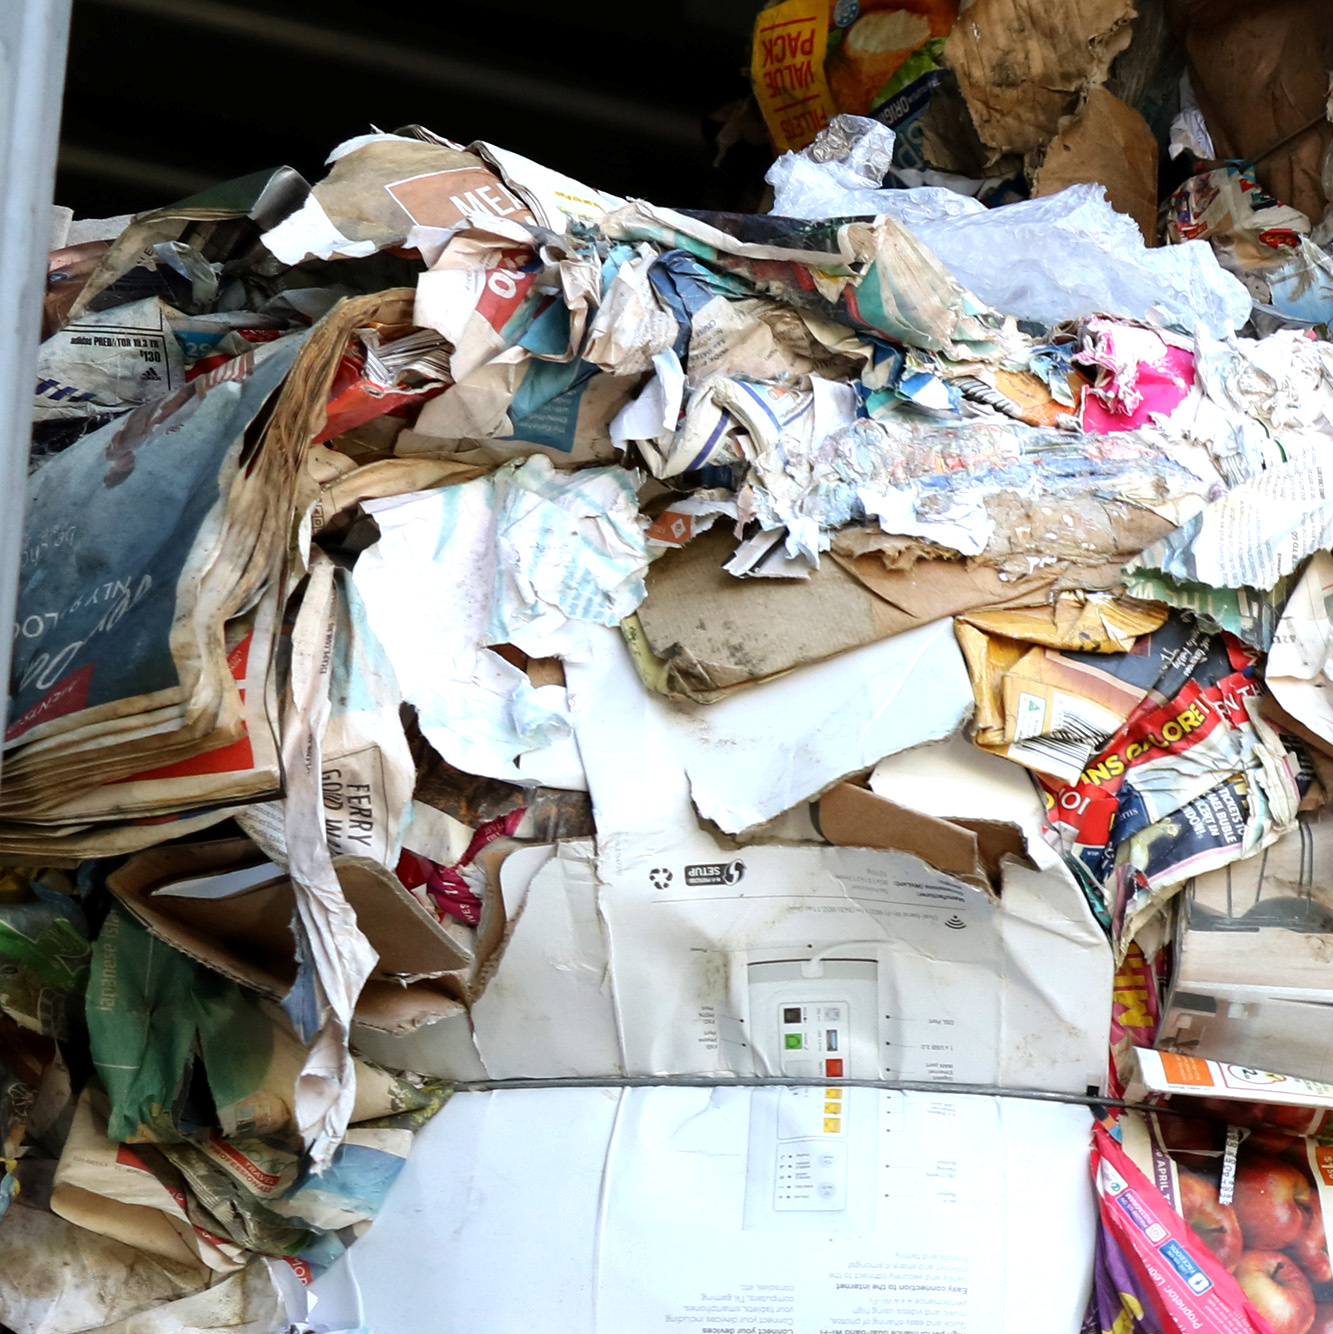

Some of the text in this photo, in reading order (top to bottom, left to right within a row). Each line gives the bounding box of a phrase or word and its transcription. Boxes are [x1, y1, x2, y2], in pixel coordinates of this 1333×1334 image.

[762, 29, 815, 68] PACK
[763, 60, 815, 98] VALUE
[93, 335, 132, 348] PREDATOR
[138, 349, 162, 364] $130
[346, 783, 372, 862] FERRY
[686, 865, 725, 877] SETUP
[1157, 1160, 1169, 1192] APRIL
[702, 1327, 736, 1334] devices
[736, 1327, 756, 1334] your
